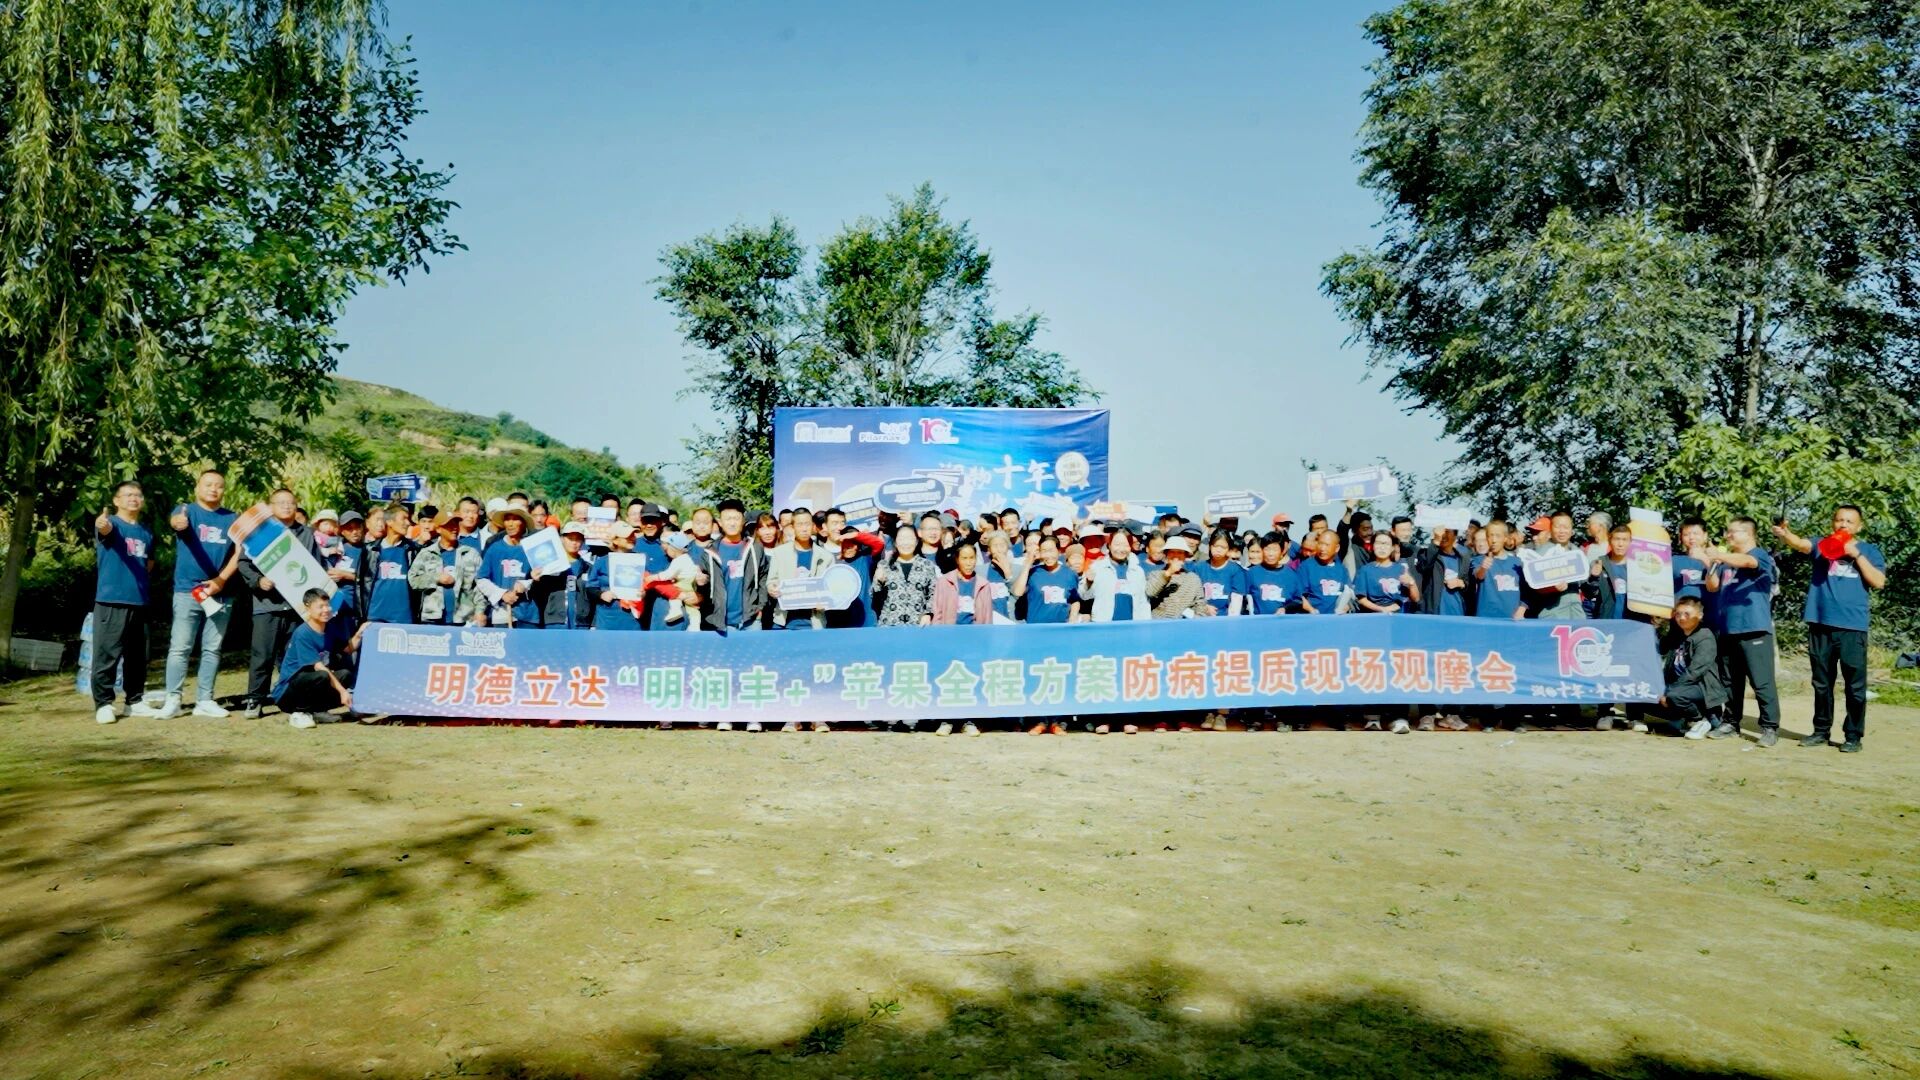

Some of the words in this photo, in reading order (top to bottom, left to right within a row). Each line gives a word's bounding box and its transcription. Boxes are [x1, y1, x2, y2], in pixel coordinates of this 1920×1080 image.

[425, 648, 1517, 710] 明德立达“明润丰+”苹果全程方案防病提质现场观摩会
